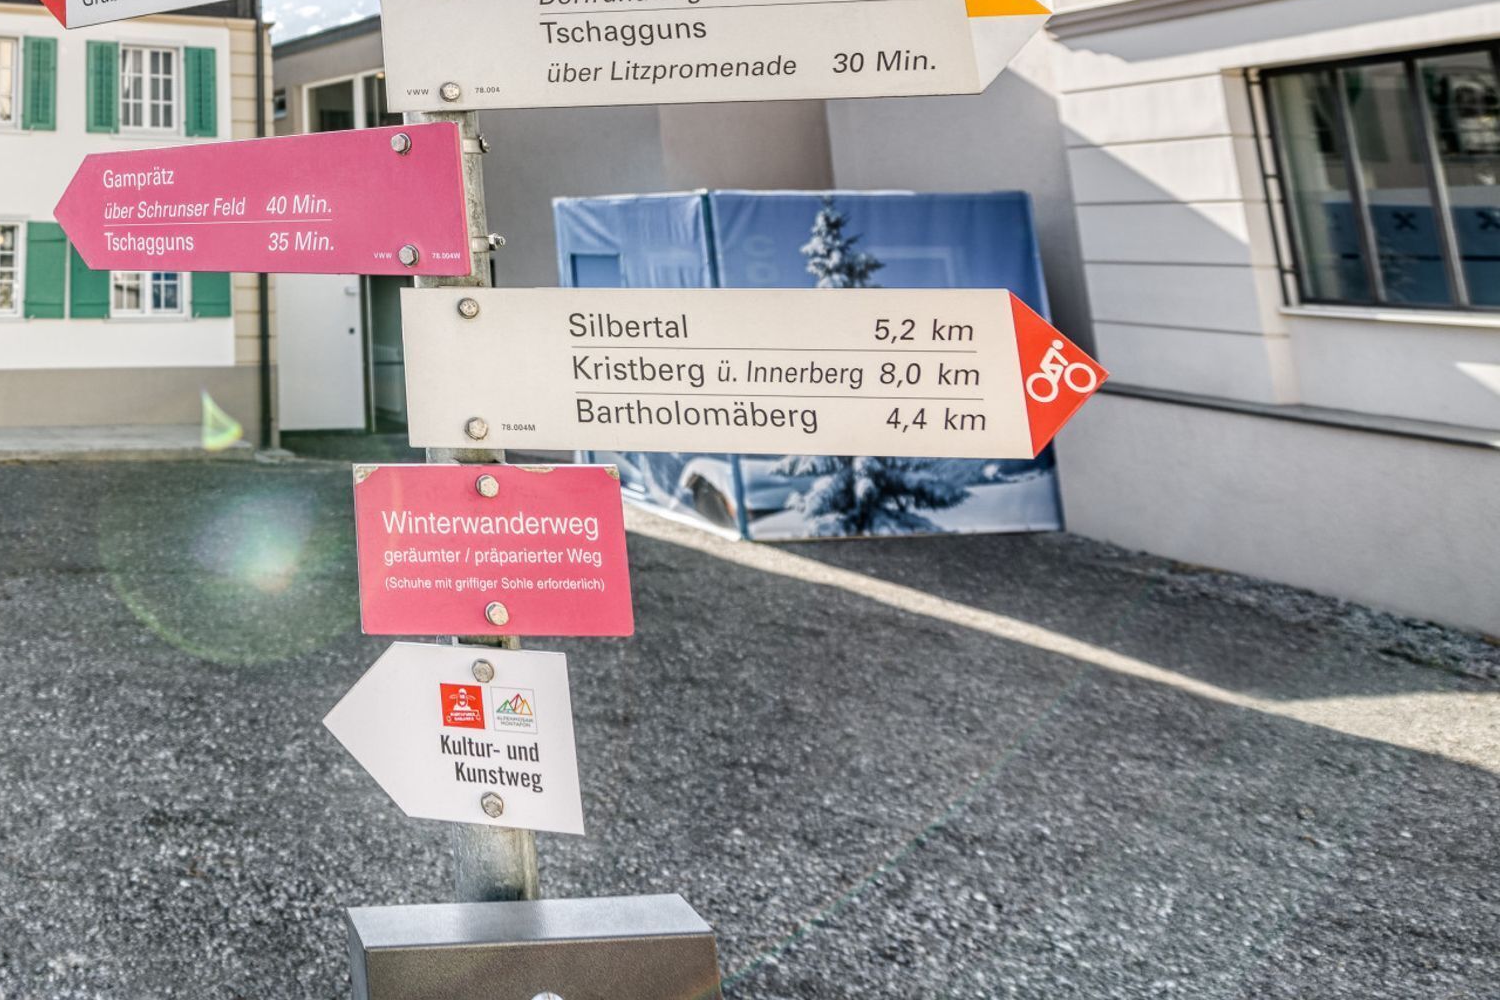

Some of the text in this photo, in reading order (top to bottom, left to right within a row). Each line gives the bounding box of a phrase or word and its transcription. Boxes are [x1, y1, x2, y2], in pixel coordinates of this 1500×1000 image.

[540, 21, 706, 46] Tschagguns
[548, 50, 935, 84] über Litzpromenade 30 Min.
[103, 167, 174, 190] Gamprätz
[105, 195, 331, 219] über Schrunser Feld 40 Min.
[104, 232, 333, 255] Tschagguns 35 Min.
[569, 313, 973, 343] Silbertal 5,2 km
[573, 356, 979, 389] Kristberg ü. Innerberg 8,0 km
[577, 399, 985, 434] Bartholomäberg 4,4 km
[382, 511, 598, 540] Winterwanderweg
[385, 548, 460, 566] geräumter
[475, 548, 563, 566] präparierter
[567, 548, 602, 567] Weg
[386, 577, 604, 592] (Schuhe mit griffiger Sohle erforderlich)
[441, 735, 539, 762] Kultur- und
[455, 762, 543, 792] Kunstweg
